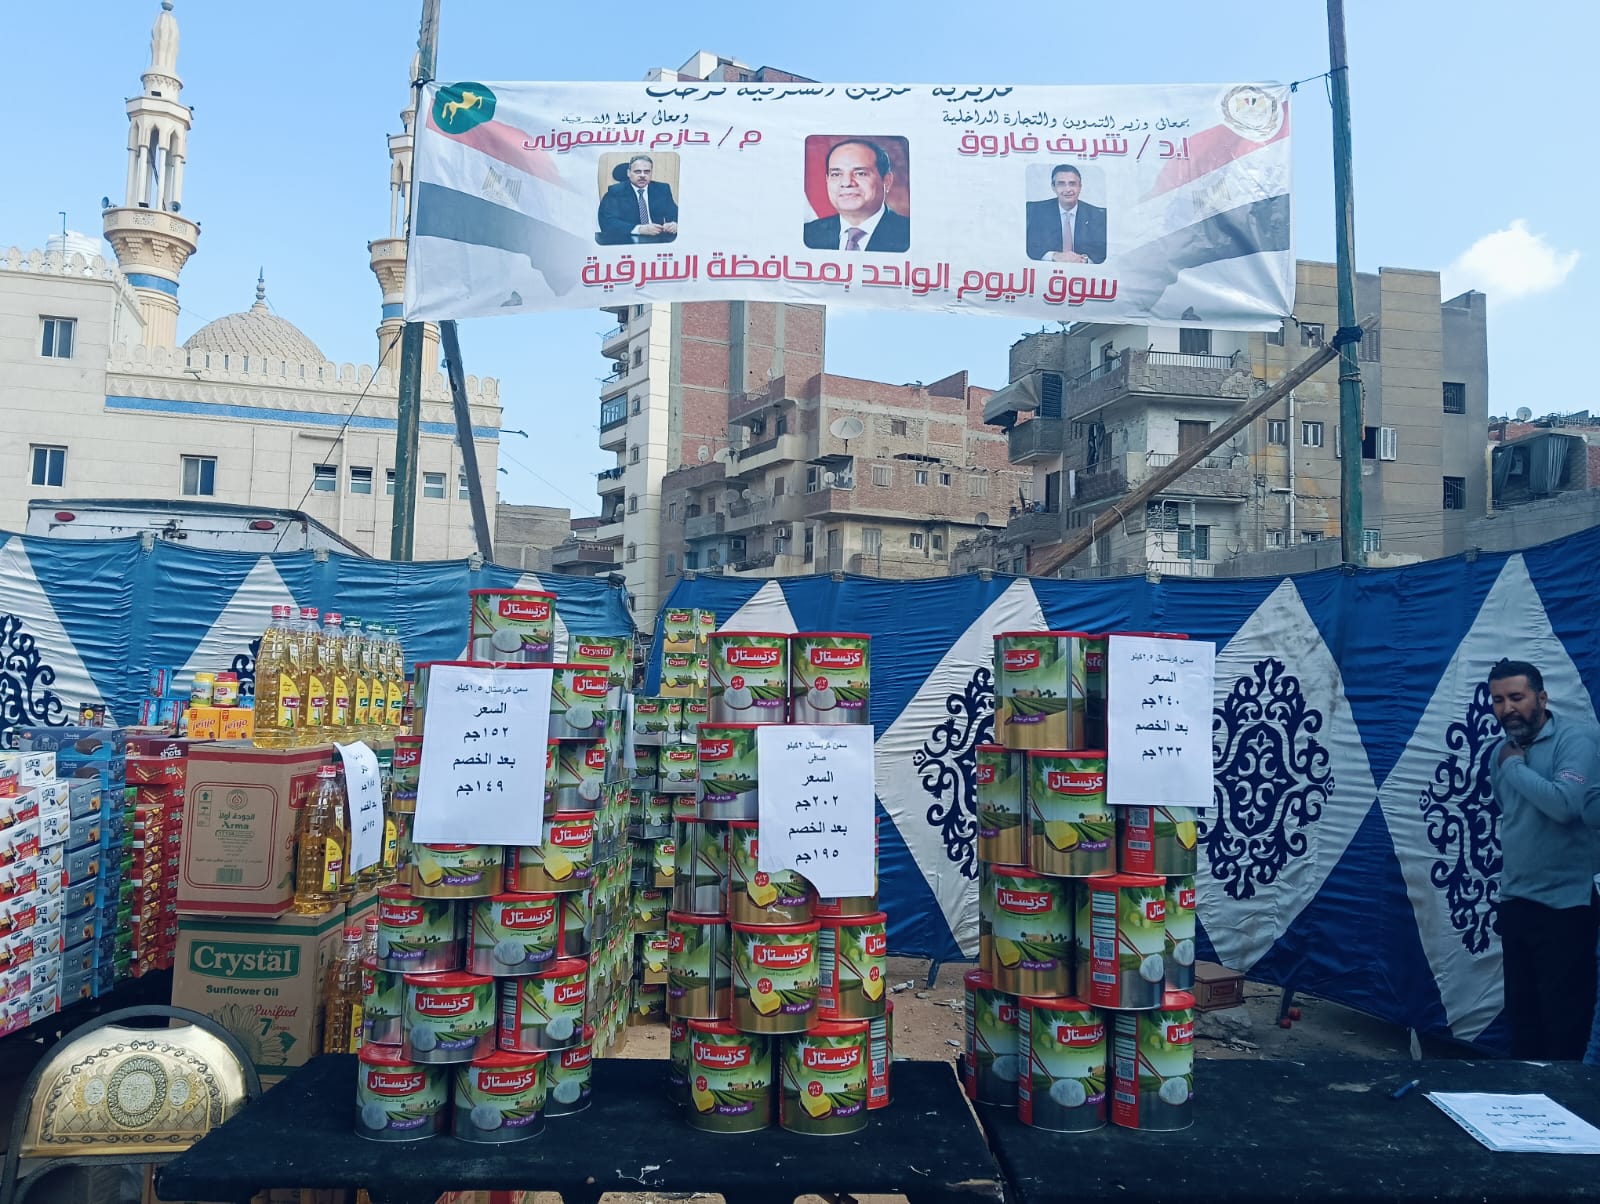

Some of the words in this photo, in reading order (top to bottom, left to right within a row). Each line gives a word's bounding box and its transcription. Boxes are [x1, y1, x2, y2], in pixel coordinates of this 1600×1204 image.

[615, 111, 648, 125] محافظ
[942, 109, 999, 125] الداخلية
[1003, 110, 1057, 129] والتجارة
[1062, 115, 1116, 130] التموين
[650, 128, 710, 150] حازم
[738, 129, 763, 150] م
[957, 130, 1040, 157] فاروق
[1045, 133, 1129, 159] شريف
[581, 252, 699, 291] الشرقية
[706, 252, 853, 291] بمحافظة
[861, 261, 950, 294] الواحد
[957, 267, 1036, 303] اليوم
[1042, 269, 1118, 305] سوق
[502, 600, 548, 619] كريستال
[730, 650, 777, 667] كريستال
[815, 650, 861, 667] كريستال
[1147, 671, 1177, 685] السعر
[485, 685, 511, 695] كريستال
[473, 701, 507, 718] السعر
[1135, 719, 1170, 735] الخصم
[1174, 722, 1189, 736] بعد
[453, 752, 492, 770] الخصم
[496, 755, 516, 768] بعد
[801, 770, 834, 786] السعر
[1052, 774, 1103, 791] كريستال
[788, 820, 826, 839] الخصم
[830, 824, 848, 836] بعد
[1000, 894, 1049, 910] كريستال
[505, 906, 552, 925] كريستال
[193, 945, 293, 977] Crystal
[757, 947, 810, 964] كريستال
[205, 984, 260, 996] Sunflower
[263, 987, 279, 997] Oil
[254, 1004, 299, 1020] Purified
[418, 995, 471, 1016] كريستال
[259, 1017, 273, 1036] 7
[697, 1043, 746, 1062] كريستال
[807, 1046, 858, 1066] كريستال
[369, 1074, 422, 1092] كريستال
[481, 1071, 533, 1090] كريستال
